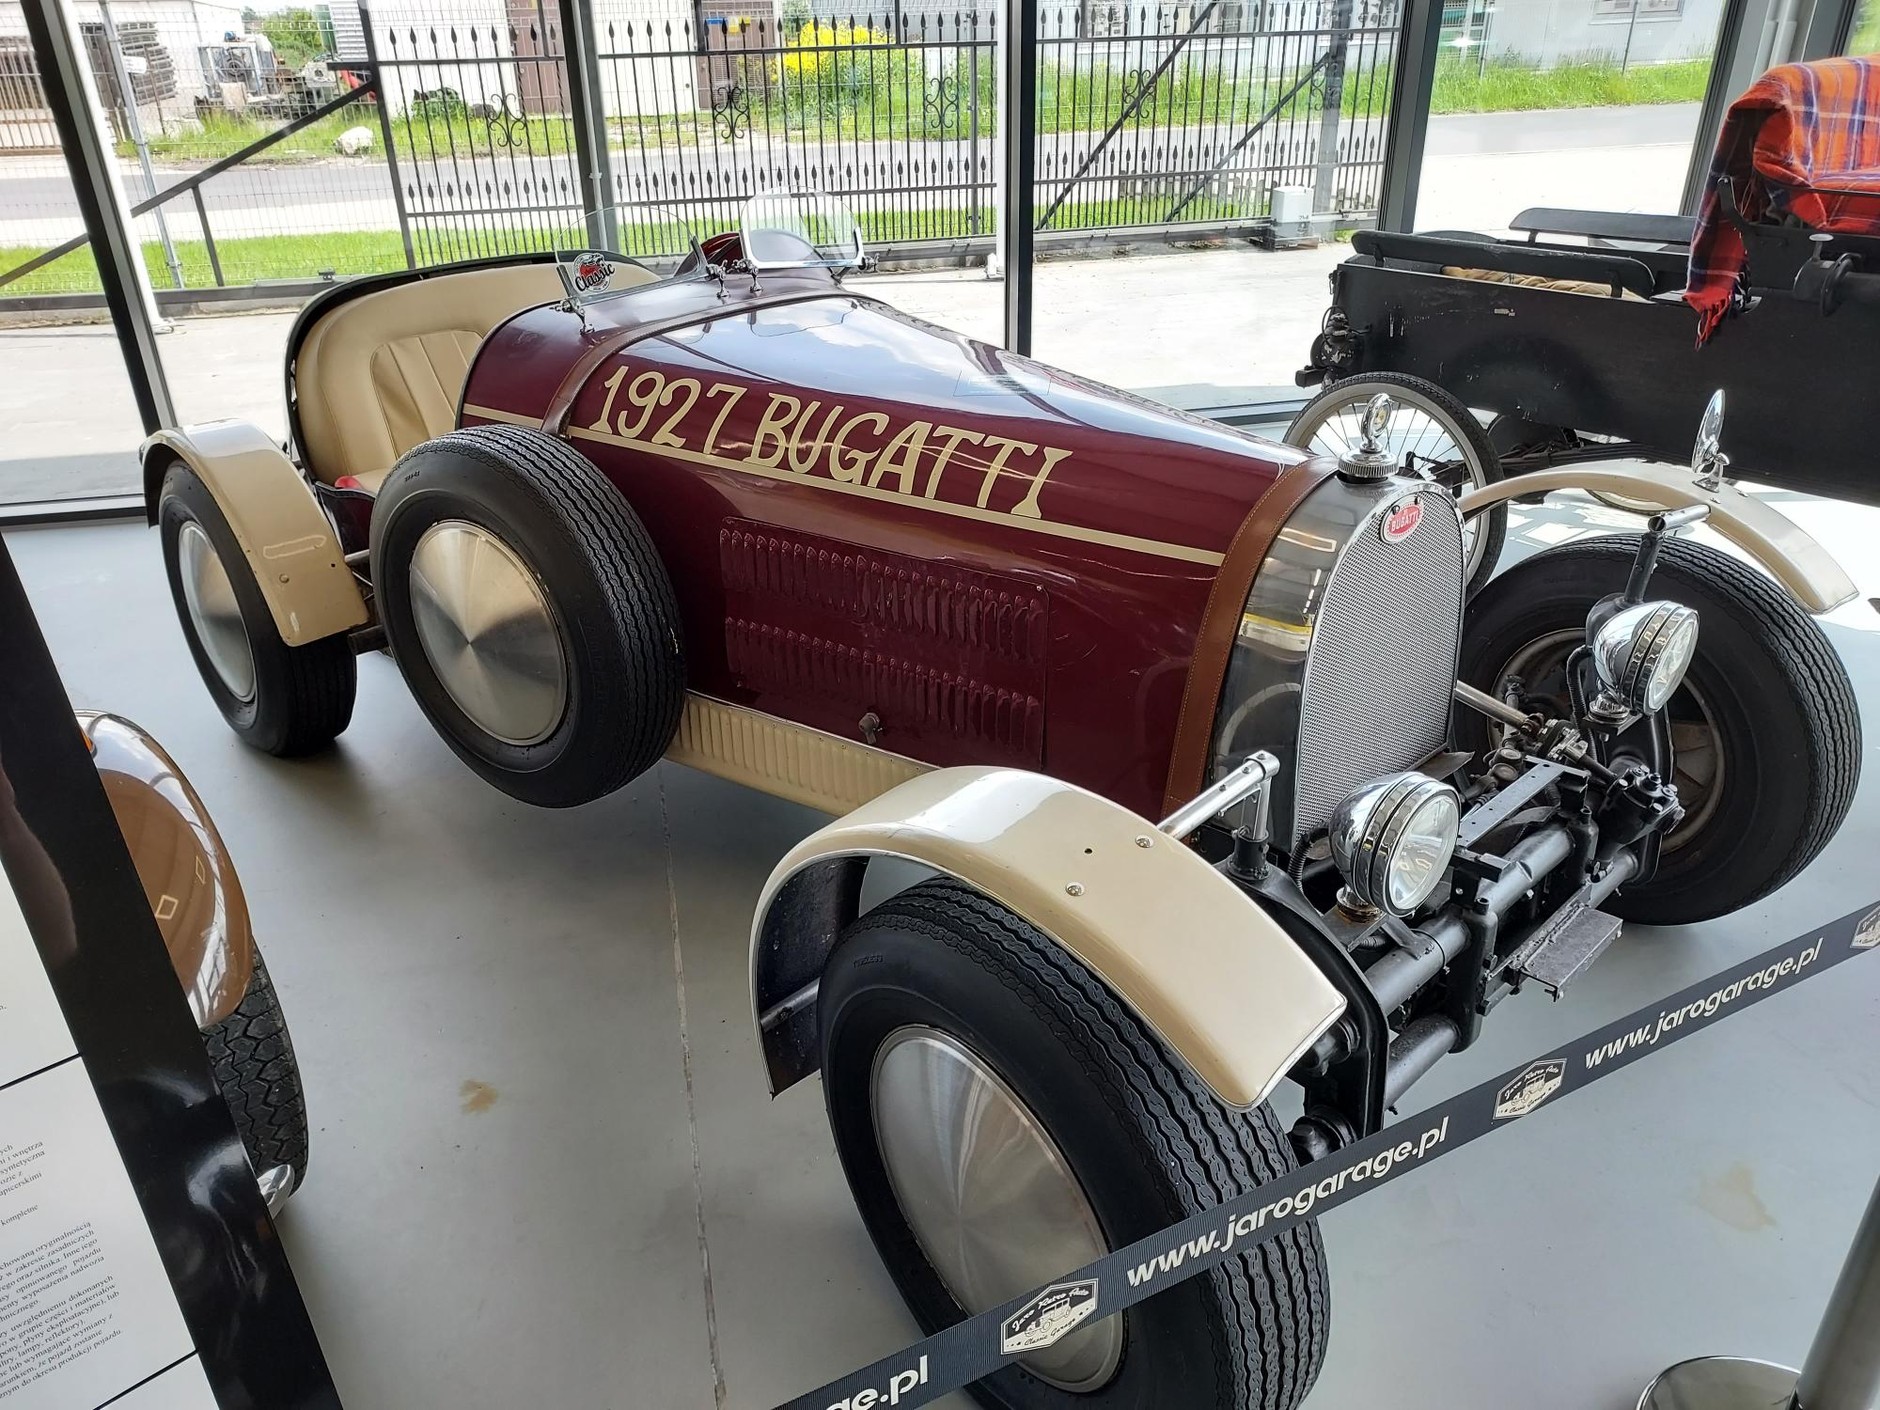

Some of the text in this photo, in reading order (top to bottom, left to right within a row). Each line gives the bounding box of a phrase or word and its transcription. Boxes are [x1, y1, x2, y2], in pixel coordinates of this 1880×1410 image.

[575, 264, 615, 291] Classic
[589, 365, 1073, 519] 1927 BUGATTI
[1391, 511, 1419, 532] BUGATTI
[1585, 938, 1823, 1069] www.jarogarage.pl
[1, 1204, 38, 1226] kompletne
[1127, 1116, 1449, 1287] www.jarogarage.pl
[15, 1254, 45, 1273] zakresie
[47, 1229, 94, 1257] zasadniczych
[15, 1264, 68, 1294] opiniowanego
[72, 1247, 102, 1267] pojazdu
[68, 1274, 113, 1302] dokonanych
[23, 1336, 71, 1364] wymagające
[47, 1345, 72, 1364] pojazd
[32, 1363, 57, 1382] okresu
